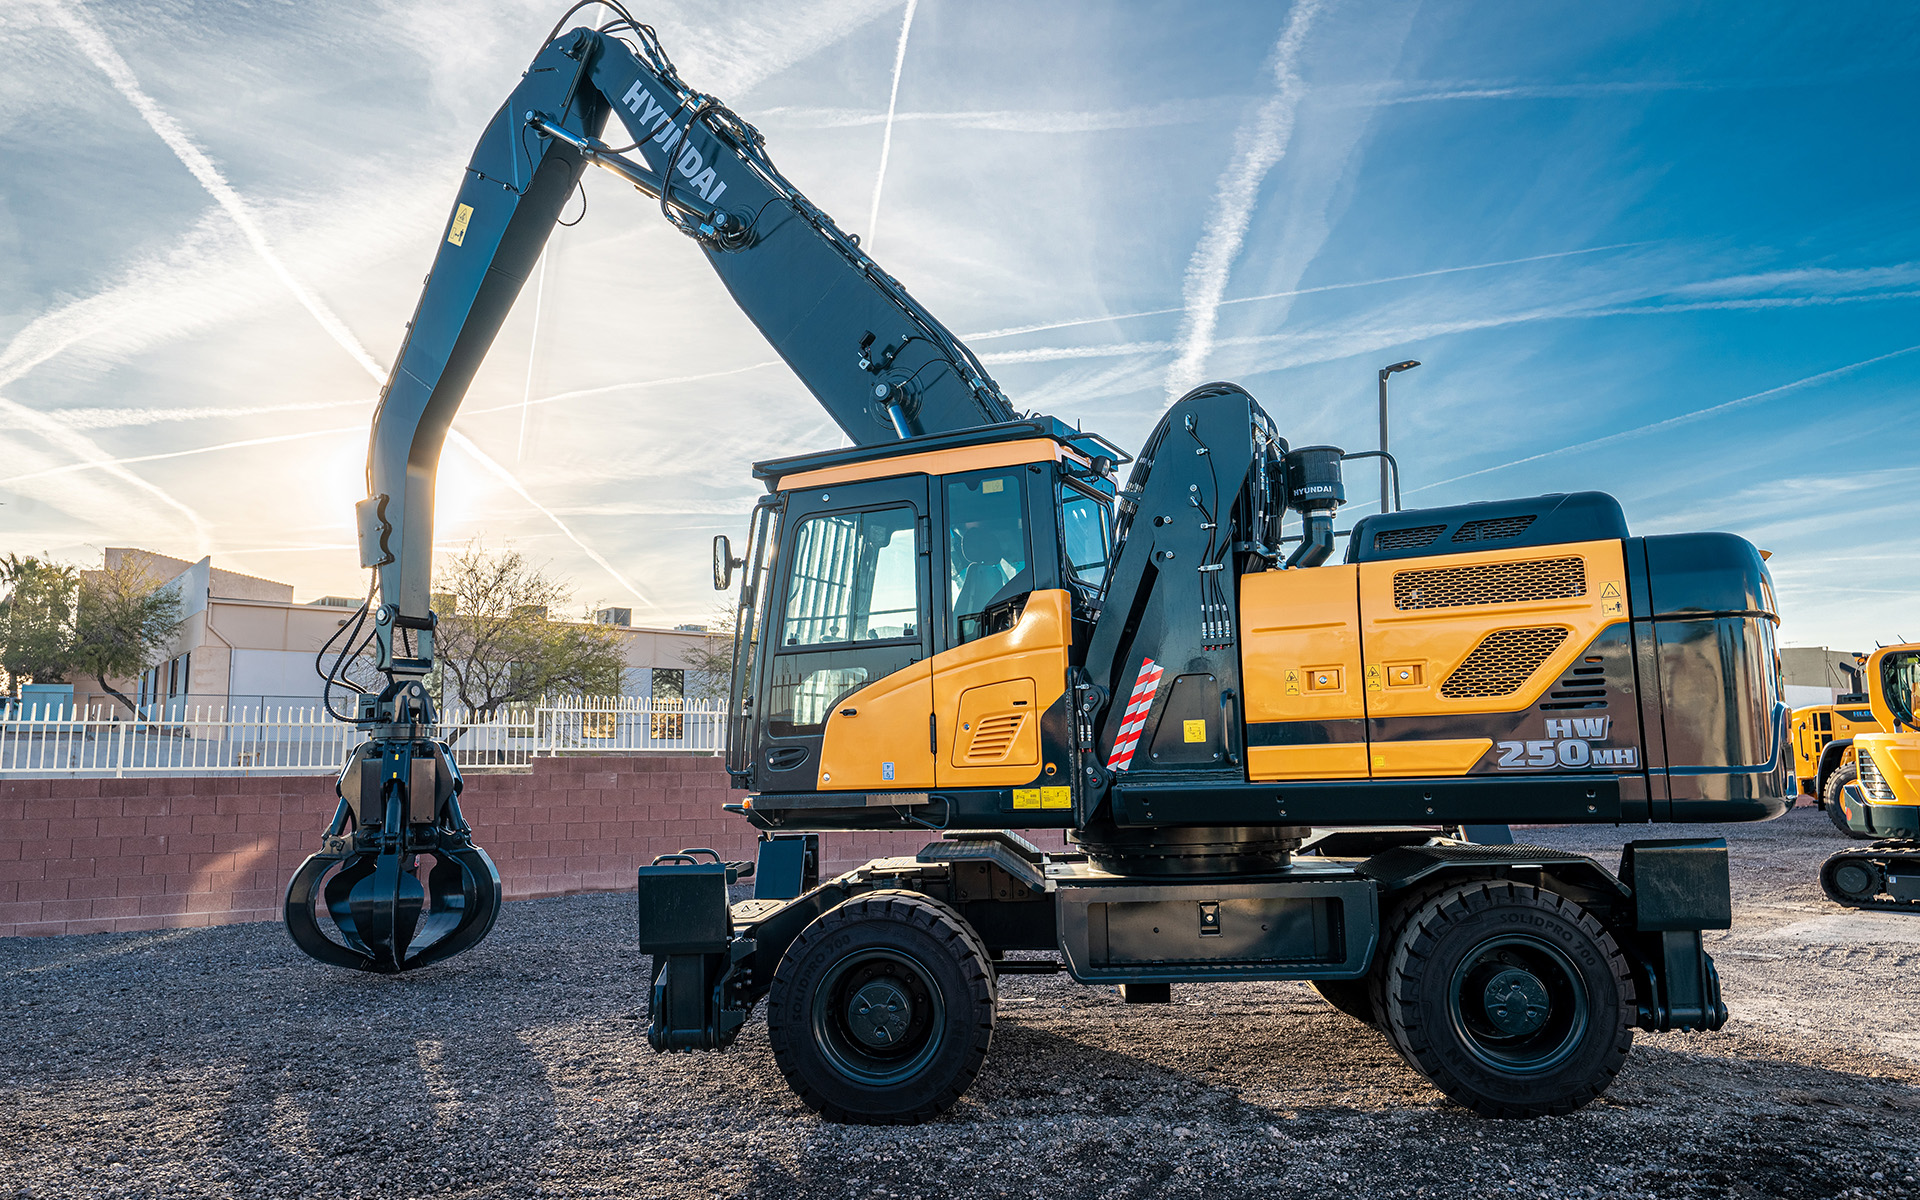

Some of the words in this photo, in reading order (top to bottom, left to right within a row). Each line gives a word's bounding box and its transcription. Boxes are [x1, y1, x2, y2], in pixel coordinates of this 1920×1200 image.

[622, 79, 727, 204] HYUNDAI
[1293, 485, 1332, 496] HYUNDAI
[1499, 912, 1573, 942] SOLIDPRO
[1573, 940, 1596, 967] 700
[793, 954, 826, 1022] SOLIDPRO
[826, 934, 852, 954] 700
